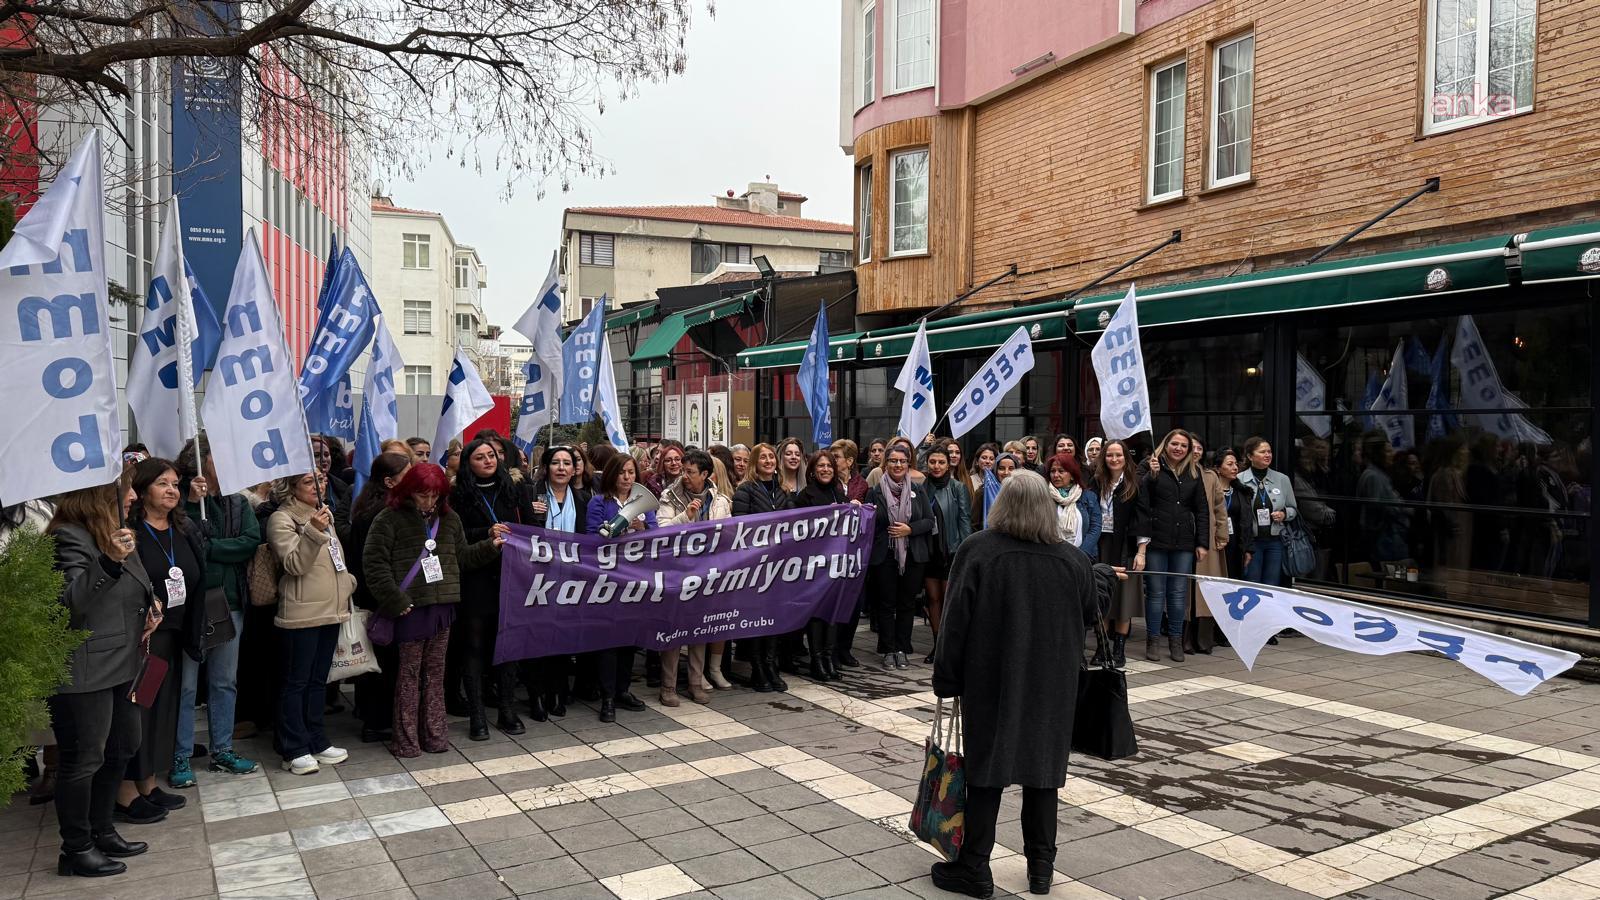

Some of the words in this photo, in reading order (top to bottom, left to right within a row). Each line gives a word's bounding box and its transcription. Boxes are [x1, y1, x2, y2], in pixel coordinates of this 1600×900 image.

[953, 343, 1028, 423] tmmob
[529, 535, 580, 563] bu
[597, 528, 720, 570] gerici
[731, 509, 863, 551] karanlığ
[524, 571, 664, 607] kabul
[679, 548, 864, 601] etmiyoruz!
[693, 623, 736, 638] Çalışma
[740, 617, 775, 629] Grubu
